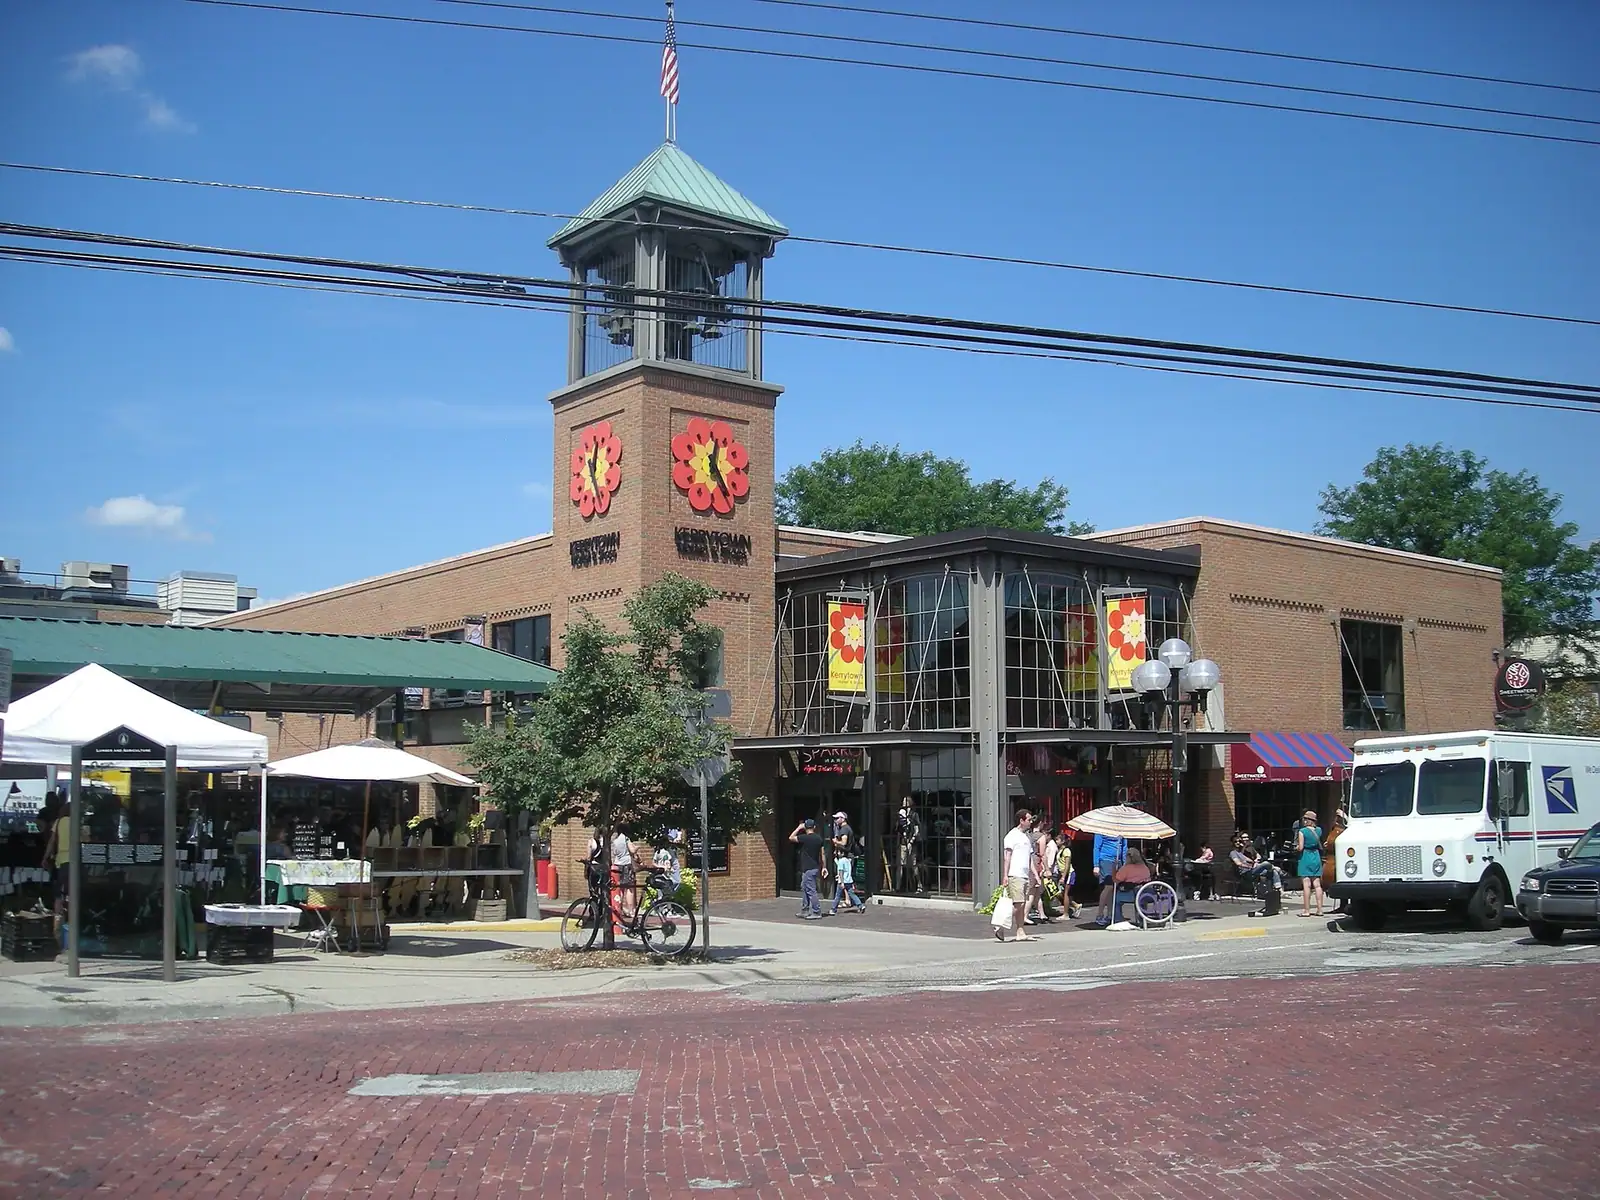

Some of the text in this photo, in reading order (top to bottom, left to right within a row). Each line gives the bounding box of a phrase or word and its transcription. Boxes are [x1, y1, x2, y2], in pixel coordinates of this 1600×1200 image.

[674, 526, 752, 556] KERRYTOWN
[830, 671, 864, 680] Kerrytown
[1499, 688, 1538, 696] SWEETWATERS
